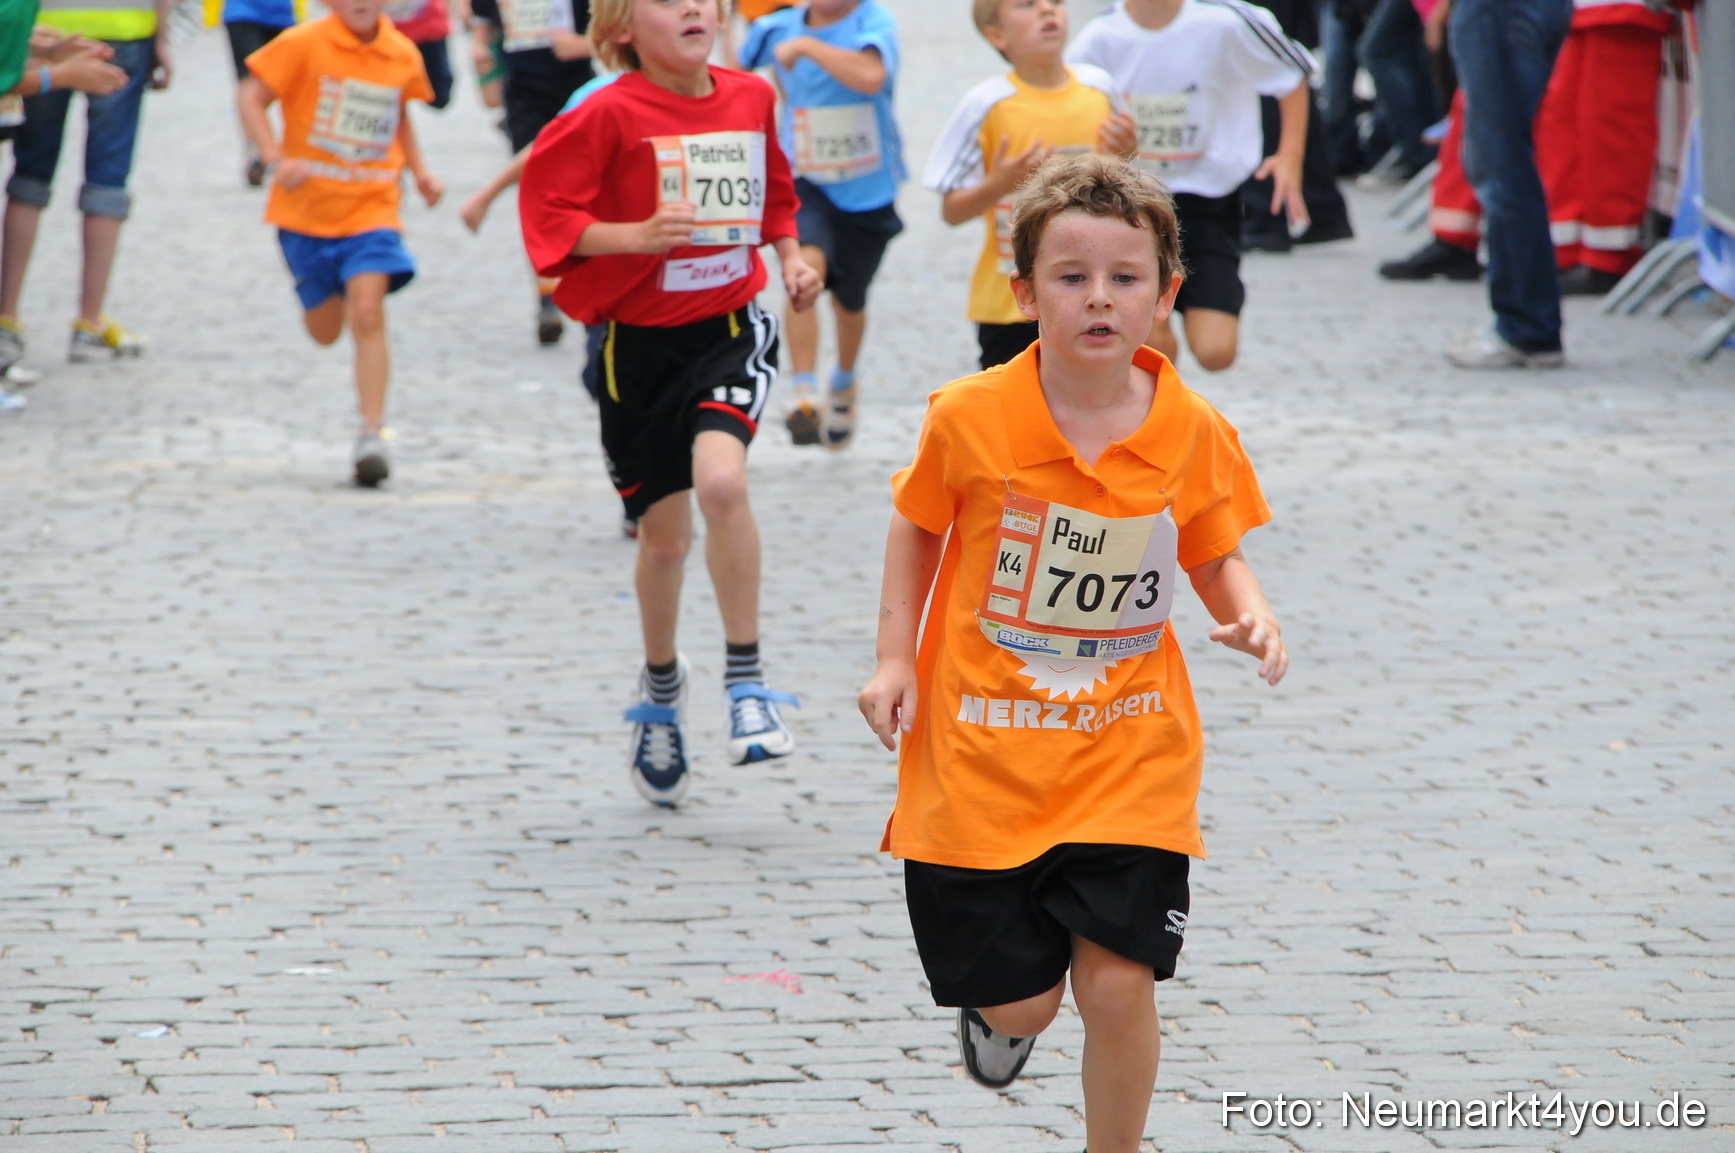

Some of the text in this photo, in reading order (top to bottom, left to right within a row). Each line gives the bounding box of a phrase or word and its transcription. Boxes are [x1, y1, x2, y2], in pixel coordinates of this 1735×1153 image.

[1136, 125, 1199, 148] 7287
[689, 143, 746, 163] Patrick
[696, 178, 761, 206] 7039
[1051, 516, 1107, 555] Paul
[998, 550, 1022, 576] K4
[1046, 565, 1160, 613] 7073
[998, 629, 1049, 648] BOCK
[1100, 630, 1160, 651] PFLEIDERER
[957, 690, 1164, 733] MERZ Reisen
